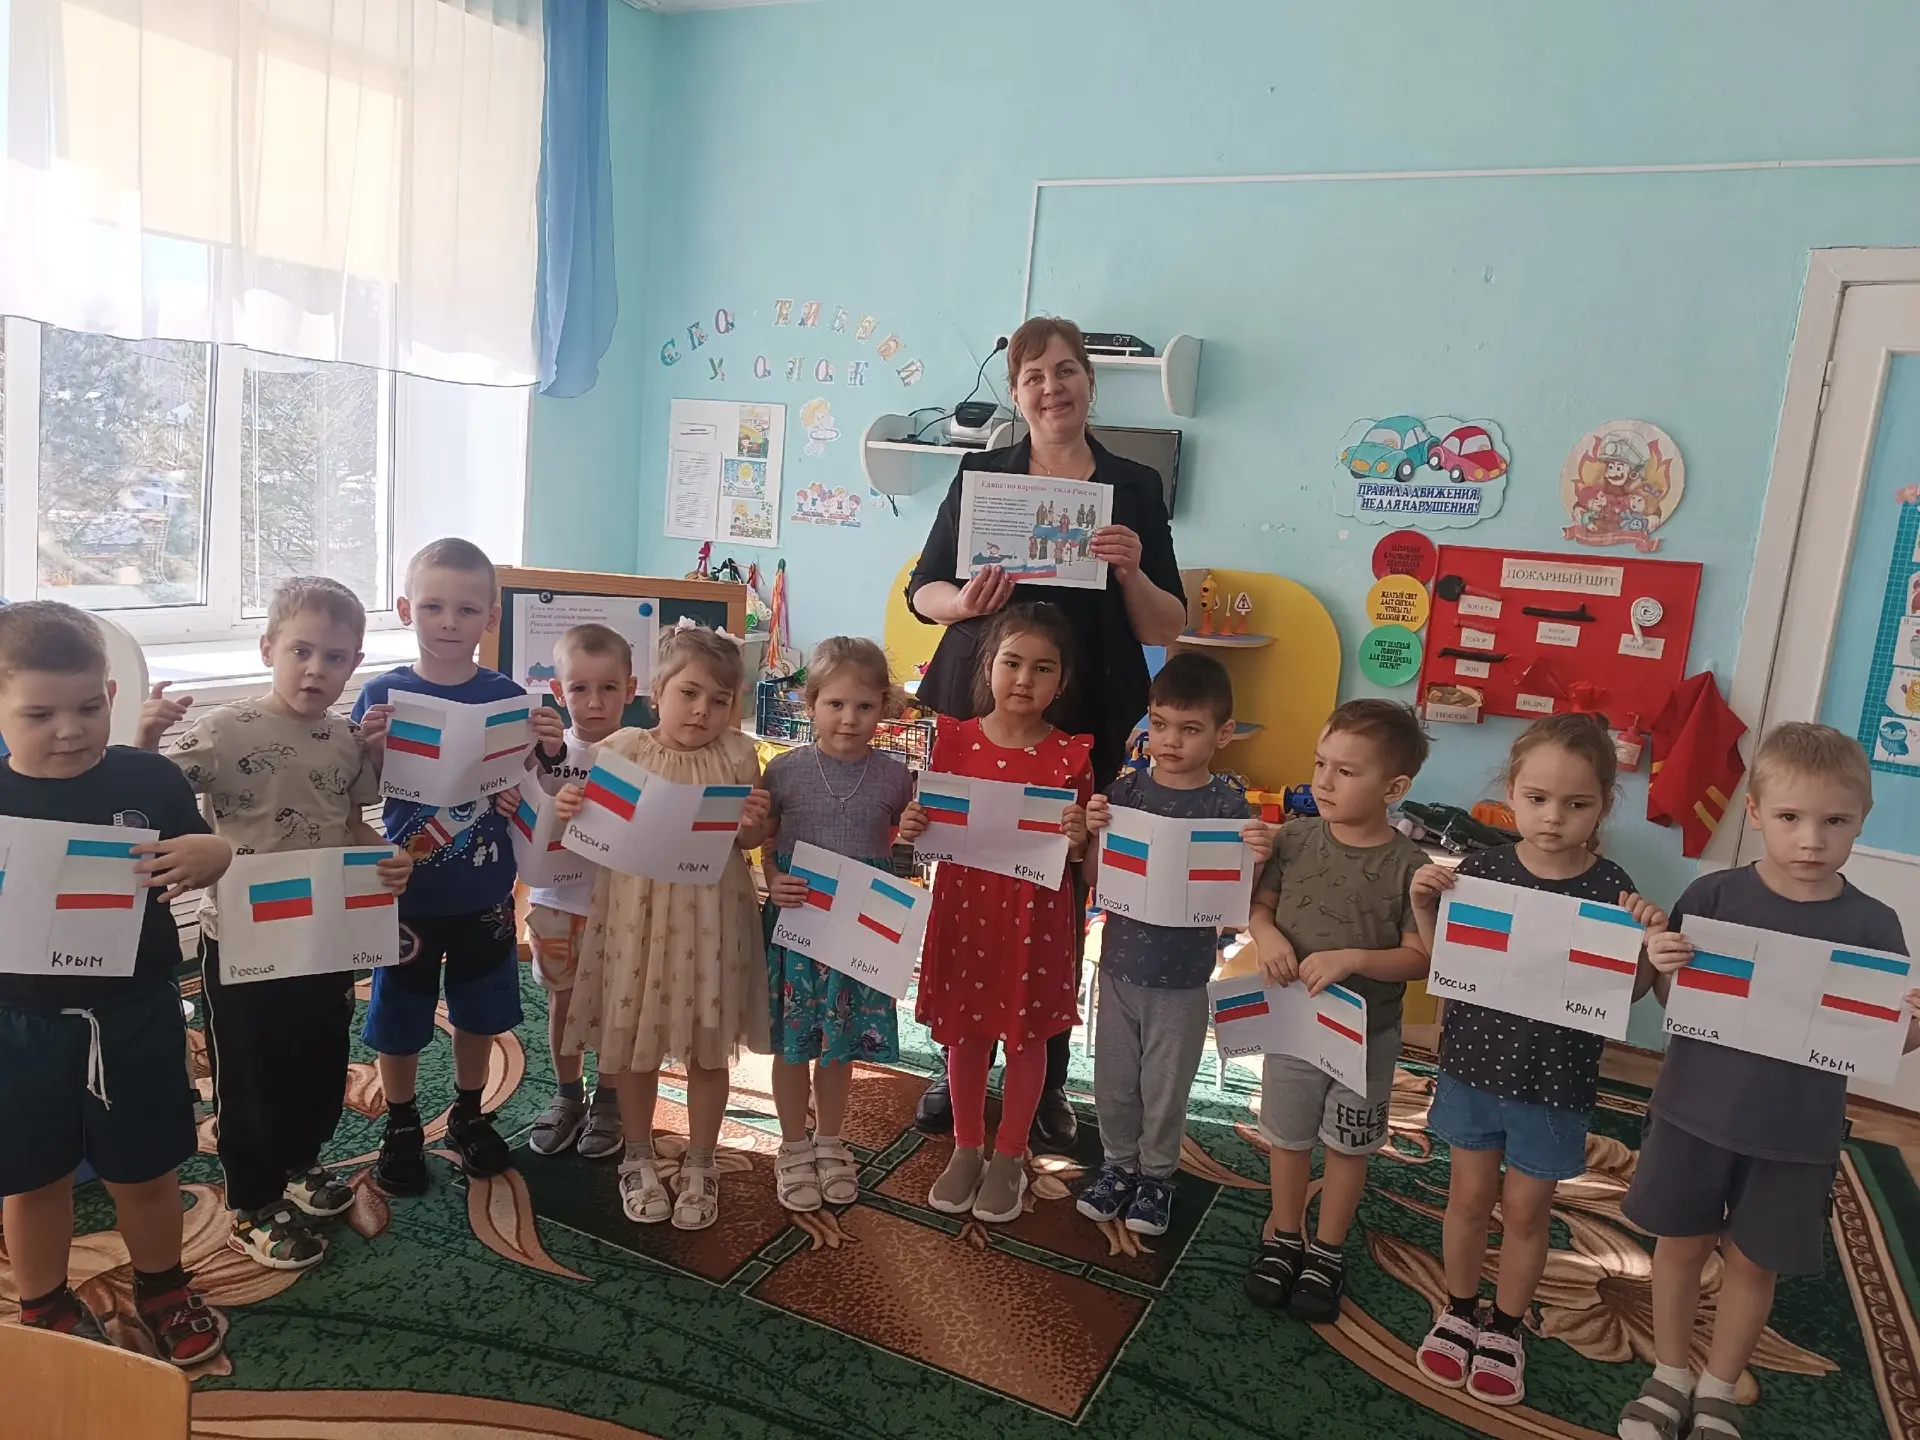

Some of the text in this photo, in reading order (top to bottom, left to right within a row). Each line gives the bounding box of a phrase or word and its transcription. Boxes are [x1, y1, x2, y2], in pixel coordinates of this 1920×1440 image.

[1358, 484, 1480, 501] ПРАВИЛА ДВИЖЕНИЯ,
[1362, 498, 1479, 514] НЕ ДЛЯ НАРУШЕНИЯ!
[1507, 569, 1618, 587] ПОЖАРНЫЙ ЩИТ
[1337, 1103, 1377, 1129] FEEL
